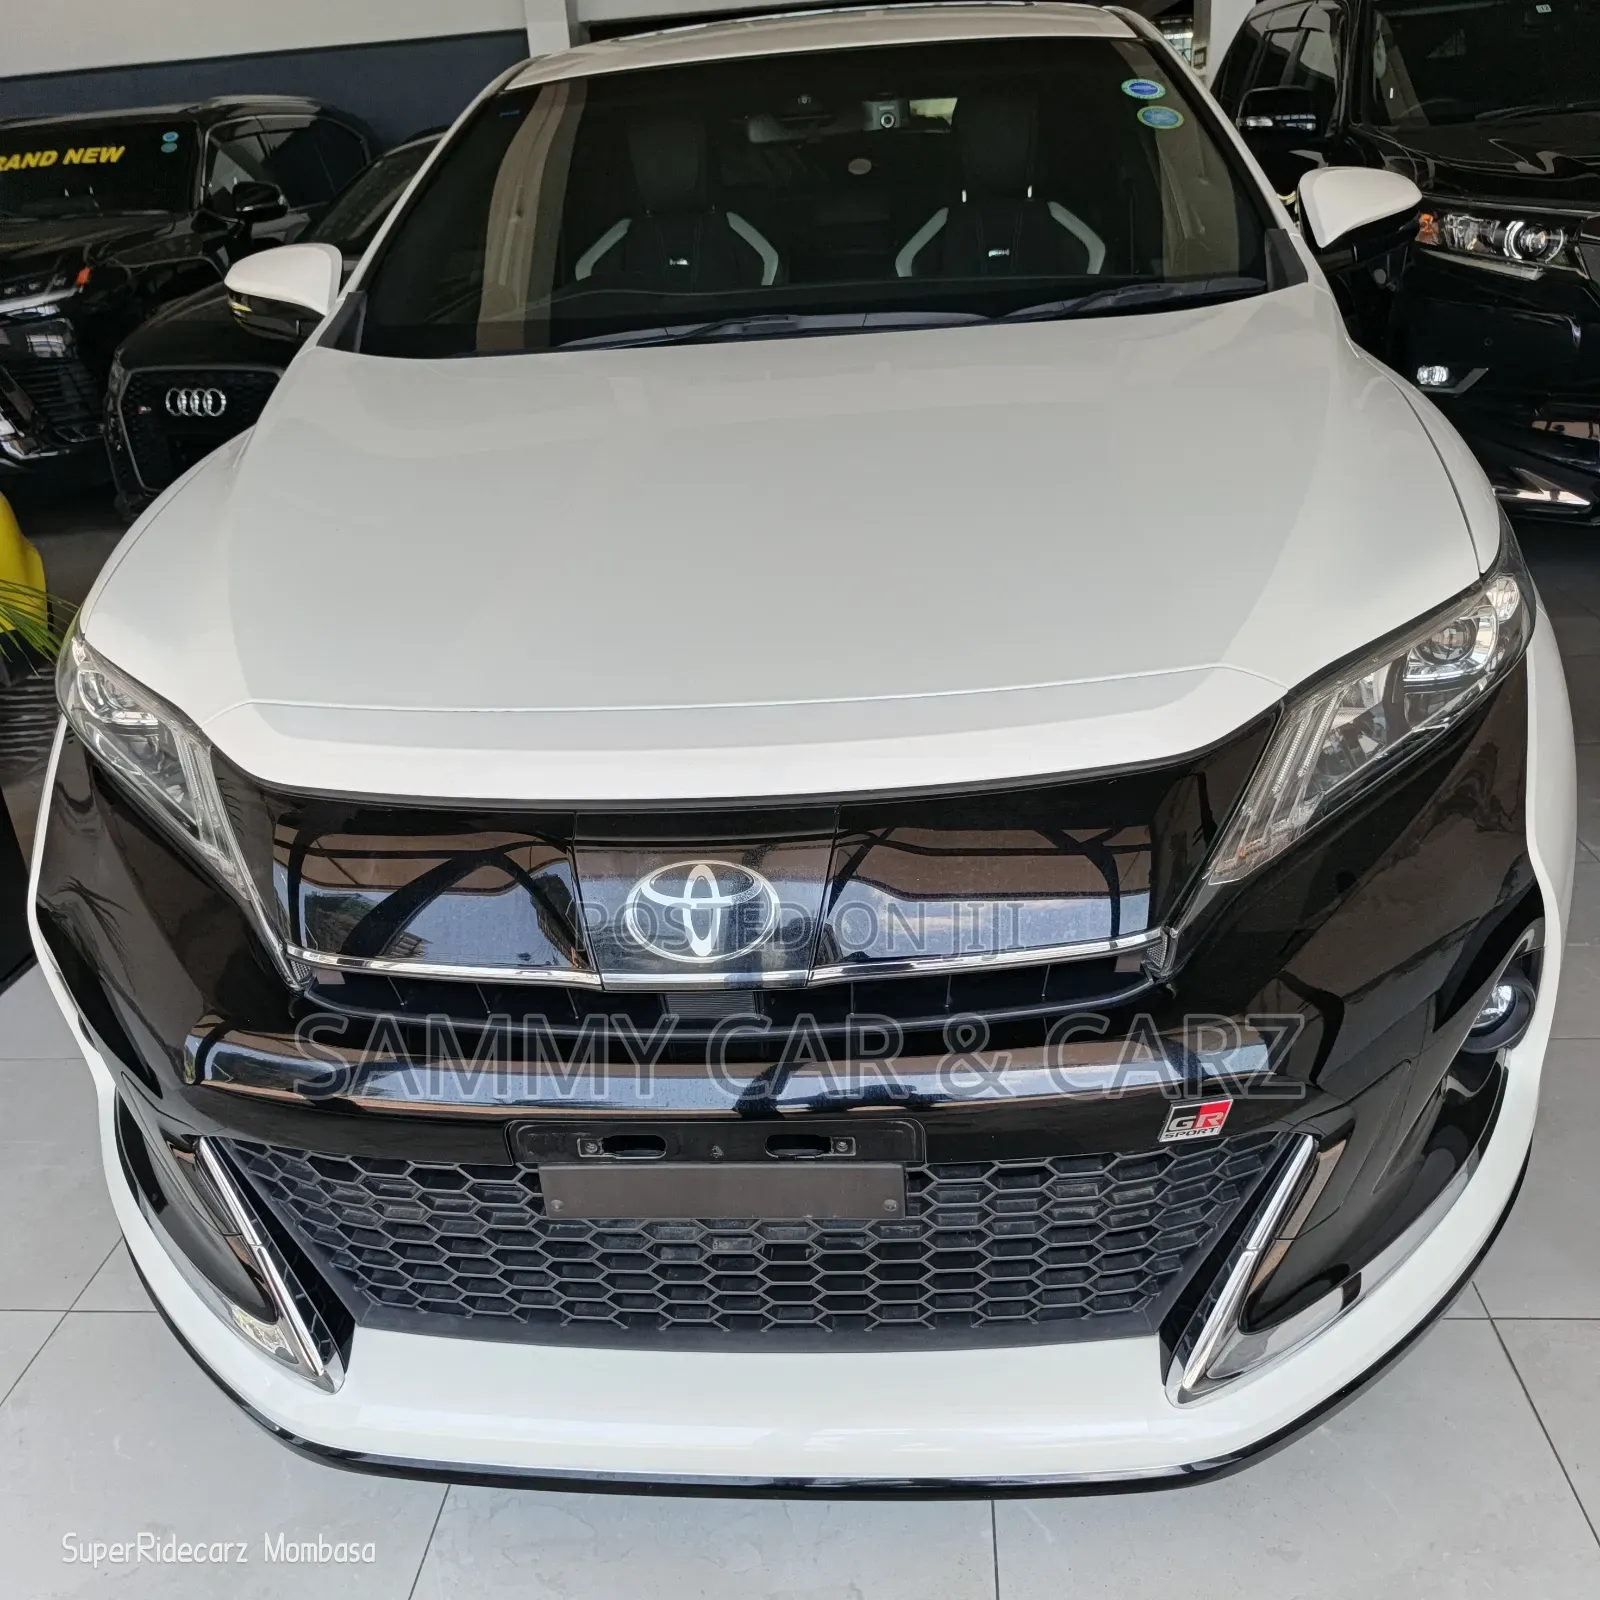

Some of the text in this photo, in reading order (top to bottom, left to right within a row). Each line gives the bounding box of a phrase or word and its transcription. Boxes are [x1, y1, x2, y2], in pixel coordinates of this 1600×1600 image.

[63, 145, 126, 165] NEW
[1169, 1112, 1224, 1130] GR
[1165, 1127, 1218, 1139] SPORT
